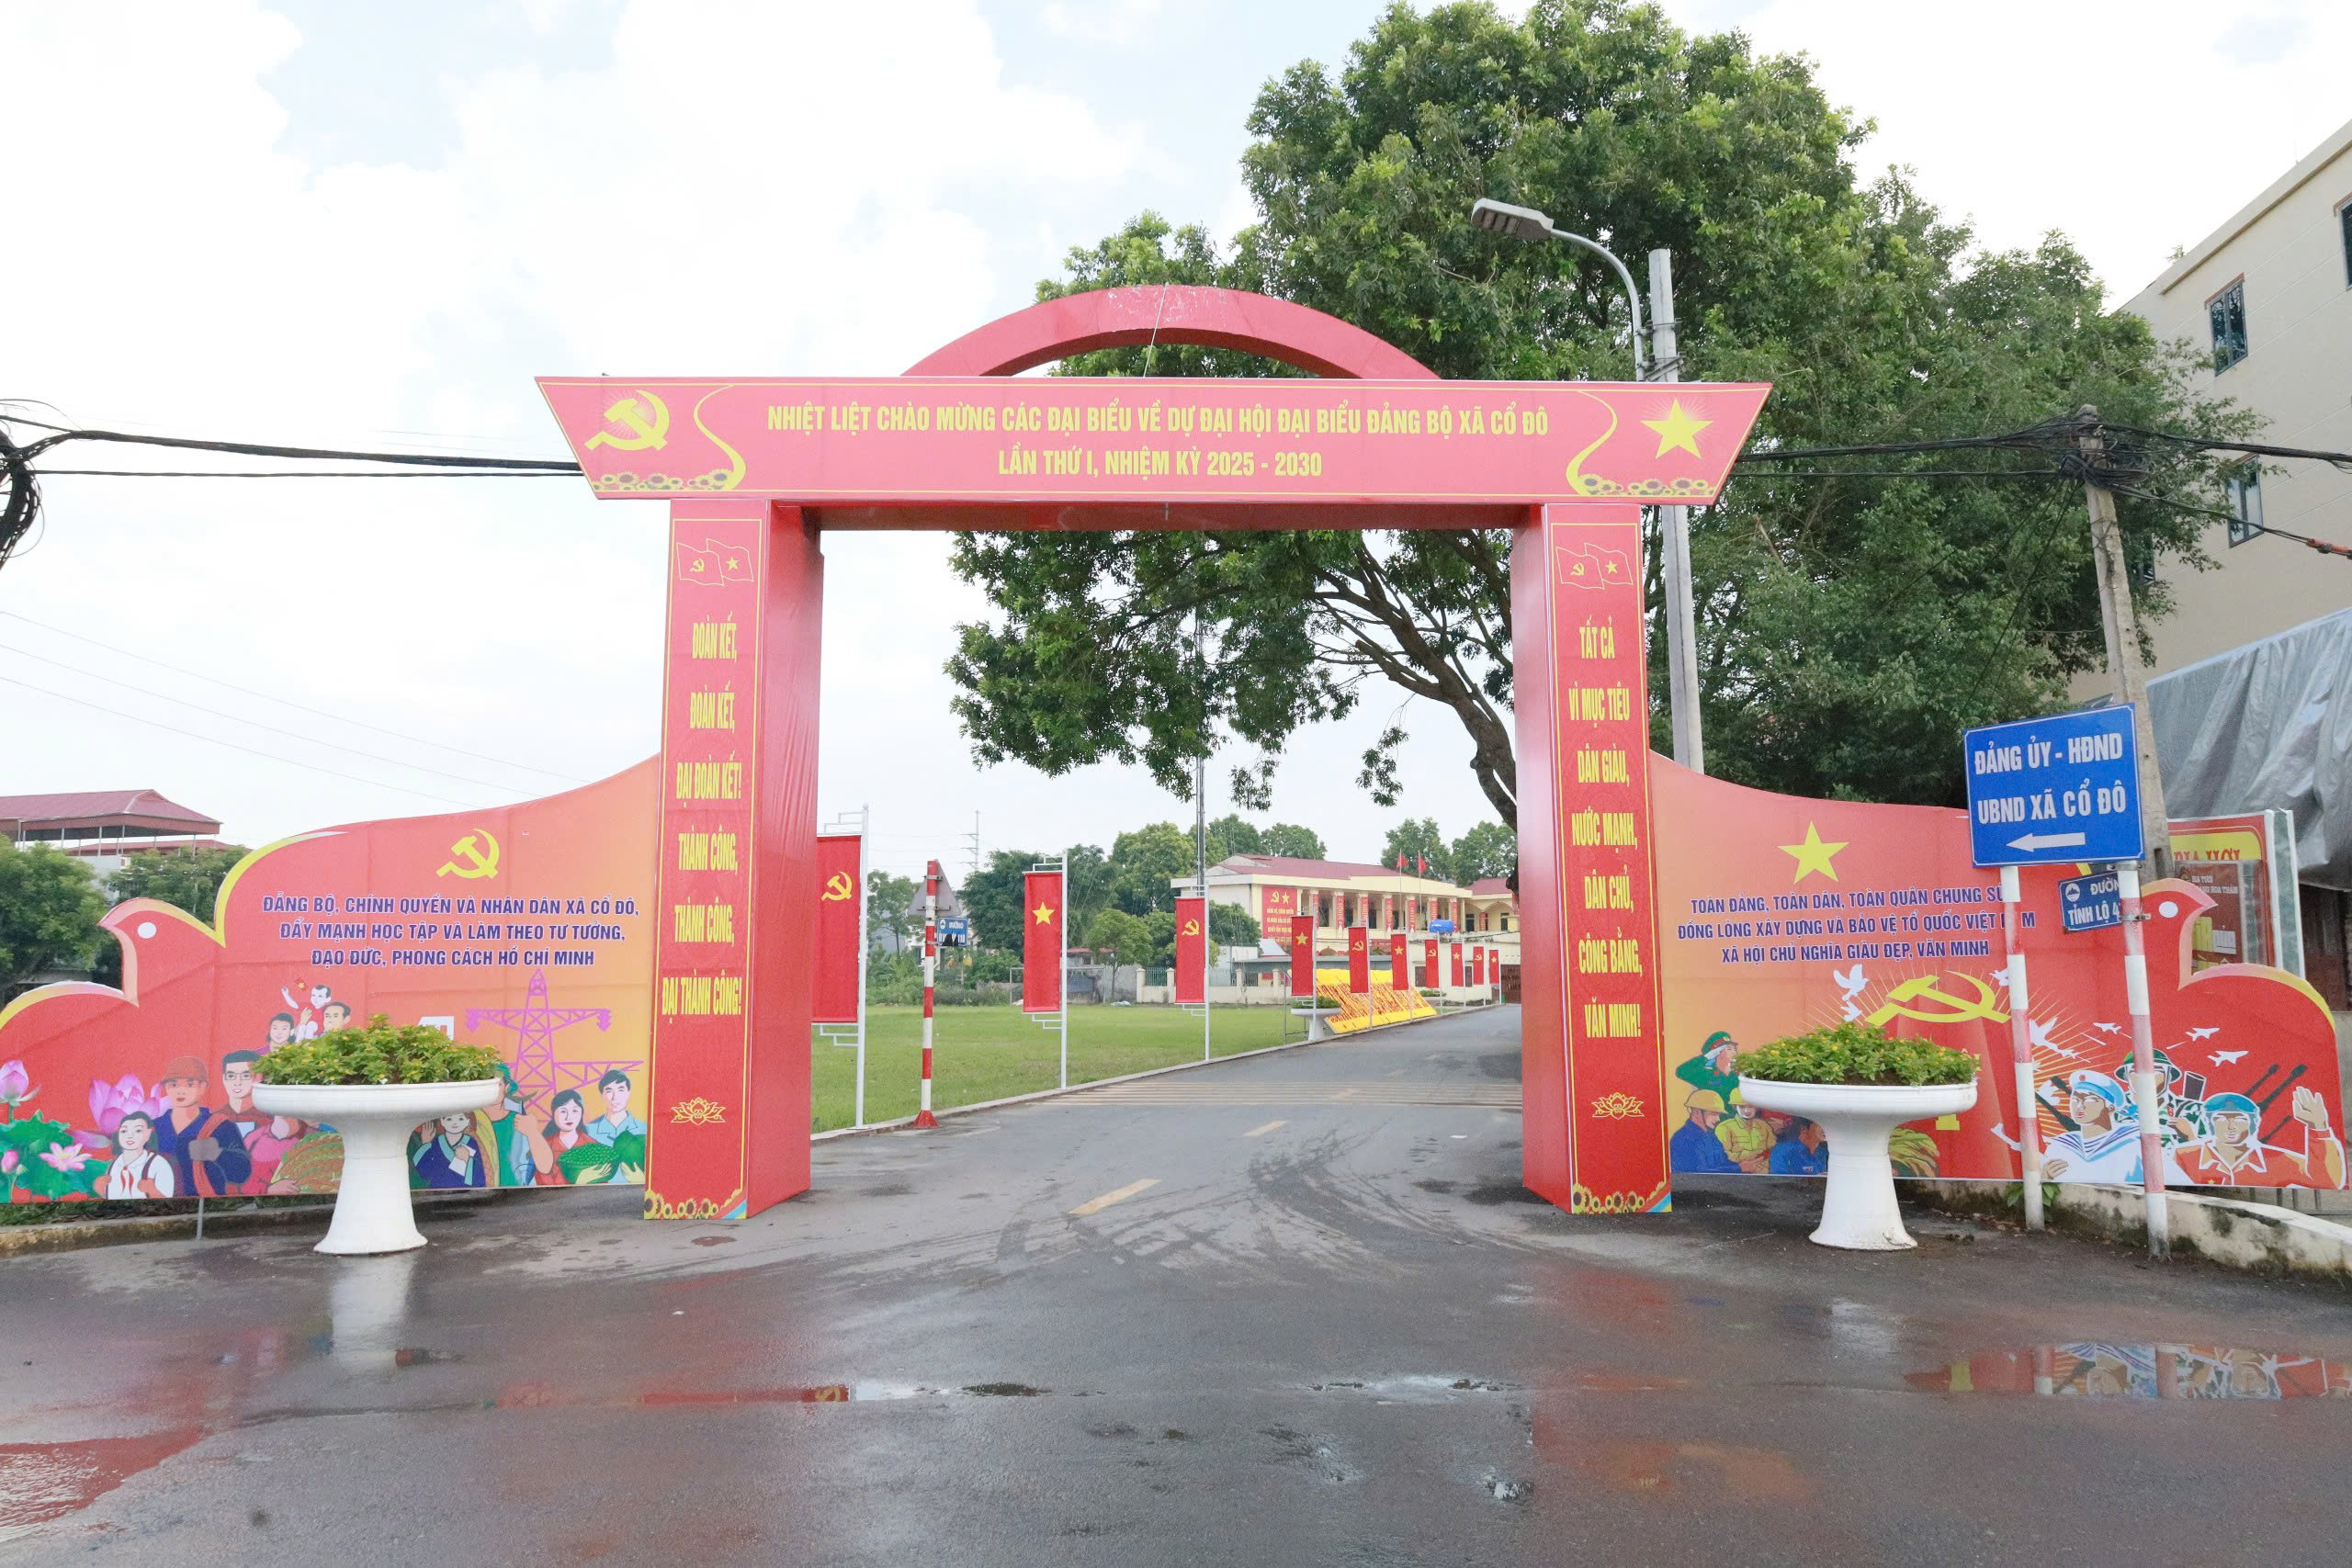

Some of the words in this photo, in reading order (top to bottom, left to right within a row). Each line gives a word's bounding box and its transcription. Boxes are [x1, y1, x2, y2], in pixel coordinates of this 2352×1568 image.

[768, 400, 825, 435] NHIỆT
[831, 401, 871, 435] LIỆT
[877, 401, 930, 431] CHÀO
[937, 401, 996, 431] MỪNG
[1002, 401, 1041, 432] CÁC
[1047, 407, 1080, 436] ĐẠI
[1087, 398, 1131, 432] BIỂU
[1137, 400, 1161, 432] VỀ
[1168, 405, 1196, 437] DỰ
[1200, 408, 1232, 437] ĐẠI
[1239, 403, 1272, 438] HỘI
[1278, 409, 1310, 438] ĐẠI
[1317, 400, 1361, 434] BIỂU
[1367, 402, 1420, 434] ĐẢNG
[1427, 405, 1453, 439] BỘ
[1459, 406, 1485, 434] XÃ
[1491, 401, 1517, 435] CỔ
[1522, 406, 1548, 435] ĐÔ
[999, 443, 1036, 475] LẦN
[1043, 445, 1082, 475] THỨ
[1087, 451, 1098, 478] I,
[1105, 446, 1169, 480] NHIỆM
[1176, 446, 1201, 476] KỲ
[1207, 451, 1254, 476] 2025
[1275, 451, 1322, 476] 2030
[693, 615, 718, 659] ĐOÀN
[719, 611, 737, 663] KẾT,
[1579, 615, 1598, 659] TẤT
[1600, 616, 1615, 659] CẢ
[690, 684, 715, 728] ĐOÀN
[718, 680, 735, 734] KẾT,
[1568, 681, 1579, 721] VÌ
[1582, 688, 1605, 728] MỤC
[1608, 681, 1630, 721] TIÊU
[1577, 743, 1600, 784] DÂN
[1602, 743, 1630, 786] GIÀU,
[1974, 740, 2022, 774] ĐẢNG
[2028, 735, 2051, 769] ỦY
[2068, 733, 2122, 763] HĐND
[676, 762, 693, 807] ĐẠI
[695, 754, 719, 799] ĐOÀN
[722, 750, 742, 799] KẾT!
[1977, 797, 2025, 824] UBND
[2030, 788, 2057, 820] XÃ
[2063, 778, 2091, 817] CỔ
[2098, 780, 2126, 815] ĐÔ
[679, 825, 708, 871] THÀNH
[710, 825, 738, 875] CÔNG,
[1571, 806, 1600, 846] NƯỚC
[1602, 812, 1638, 853] MẠNH,
[263, 891, 309, 912] ĐẢNG
[313, 894, 339, 916] BỘ,
[345, 895, 394, 913] CHÍNH
[400, 893, 451, 914] QUYỀN
[457, 896, 476, 914] VÀ
[481, 897, 524, 915] NHÂN
[529, 897, 560, 915] DÂN
[566, 897, 585, 915] XÃ
[591, 894, 612, 915] CỔ
[615, 897, 639, 917] ĐÔ,
[1585, 868, 1607, 909] DÂN
[1609, 864, 1634, 913] CHỦ,
[1690, 897, 1724, 914] TOÀN
[1729, 893, 1769, 912] ĐẢNG,
[1772, 892, 1808, 911] TOÀN
[1813, 891, 1845, 909] DÂN,
[1849, 889, 1884, 908] TOÀN
[1890, 887, 1928, 907] QUÂN
[1933, 887, 1982, 904] CHUNG
[2090, 877, 2119, 896] ĐƯỜN
[280, 918, 312, 939] ĐẨY
[317, 923, 367, 942] MẠNH
[371, 923, 403, 942] HỌC
[409, 920, 438, 943] TẬP
[443, 921, 463, 940] VÀ
[468, 921, 501, 940] LÀM
[506, 924, 544, 941] THEO
[549, 923, 569, 941] TƯ
[571, 920, 625, 941] TƯỞNG,
[674, 897, 705, 942] THÀNH
[707, 897, 734, 947] CÔNG,
[1678, 920, 1713, 939] ĐỒNG
[1717, 920, 1751, 938] LÒNG
[1756, 919, 1781, 937] XÂY
[1785, 919, 1822, 939] DỰNG
[1826, 917, 1844, 934] VÀ
[1849, 914, 1876, 933] BẢO
[1881, 915, 1897, 936] VỆ
[1902, 910, 1918, 931] TỔ
[1924, 909, 1961, 931] QUỐC
[1966, 911, 1996, 933] VIỆT
[2068, 904, 2094, 925] TỈNH
[2096, 900, 2109, 923] LỘ
[311, 950, 345, 968] ĐẠO
[349, 945, 387, 967] ĐỨC,
[392, 950, 447, 965] PHONG
[451, 947, 492, 965] CÁCH
[498, 945, 518, 965] HỒ
[524, 948, 548, 965] CHÍ
[554, 951, 594, 965] MINH
[1578, 932, 1608, 974] CÔNG
[1610, 927, 1643, 977] BẰNG,
[1722, 946, 1739, 963] XÃ
[1743, 944, 1765, 964] HỘI
[1770, 942, 1795, 961] CHỦ
[1801, 942, 1842, 961] NGHĨA
[1848, 942, 1879, 959] GIÀU
[1883, 942, 1913, 962] ĐẸP,
[1917, 940, 1946, 957] VĂN
[1951, 940, 1989, 956] MINH
[662, 976, 678, 1024] ĐẠI
[681, 969, 711, 1015] THÀNH
[714, 969, 742, 1015] CÔNG!
[1585, 997, 1607, 1038] VĂN
[1609, 1004, 1641, 1038] MINH!
